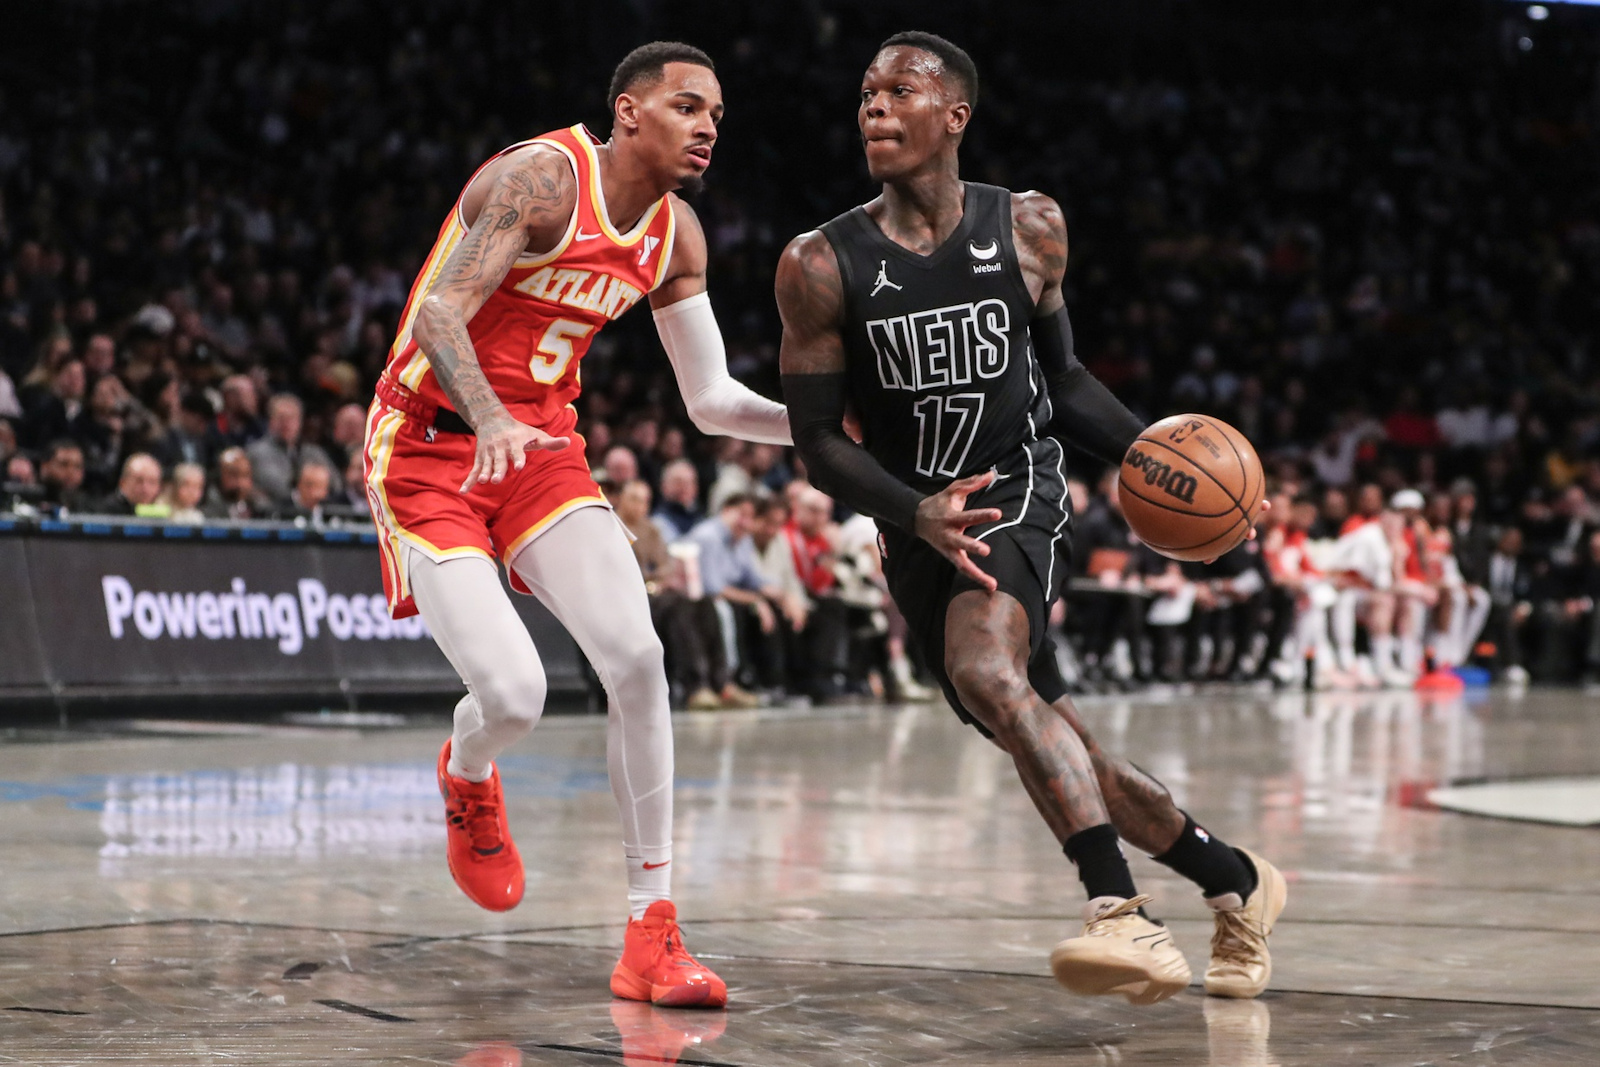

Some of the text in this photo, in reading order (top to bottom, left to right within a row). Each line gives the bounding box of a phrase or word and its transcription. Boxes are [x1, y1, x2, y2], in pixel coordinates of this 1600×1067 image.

[514, 266, 645, 320] ATLANT
[973, 262, 1002, 274] Webull
[529, 318, 594, 385] 5
[866, 299, 1010, 391] NETS
[913, 393, 985, 478] 17
[1124, 447, 1199, 505] Wilson
[102, 575, 303, 655] Powering
